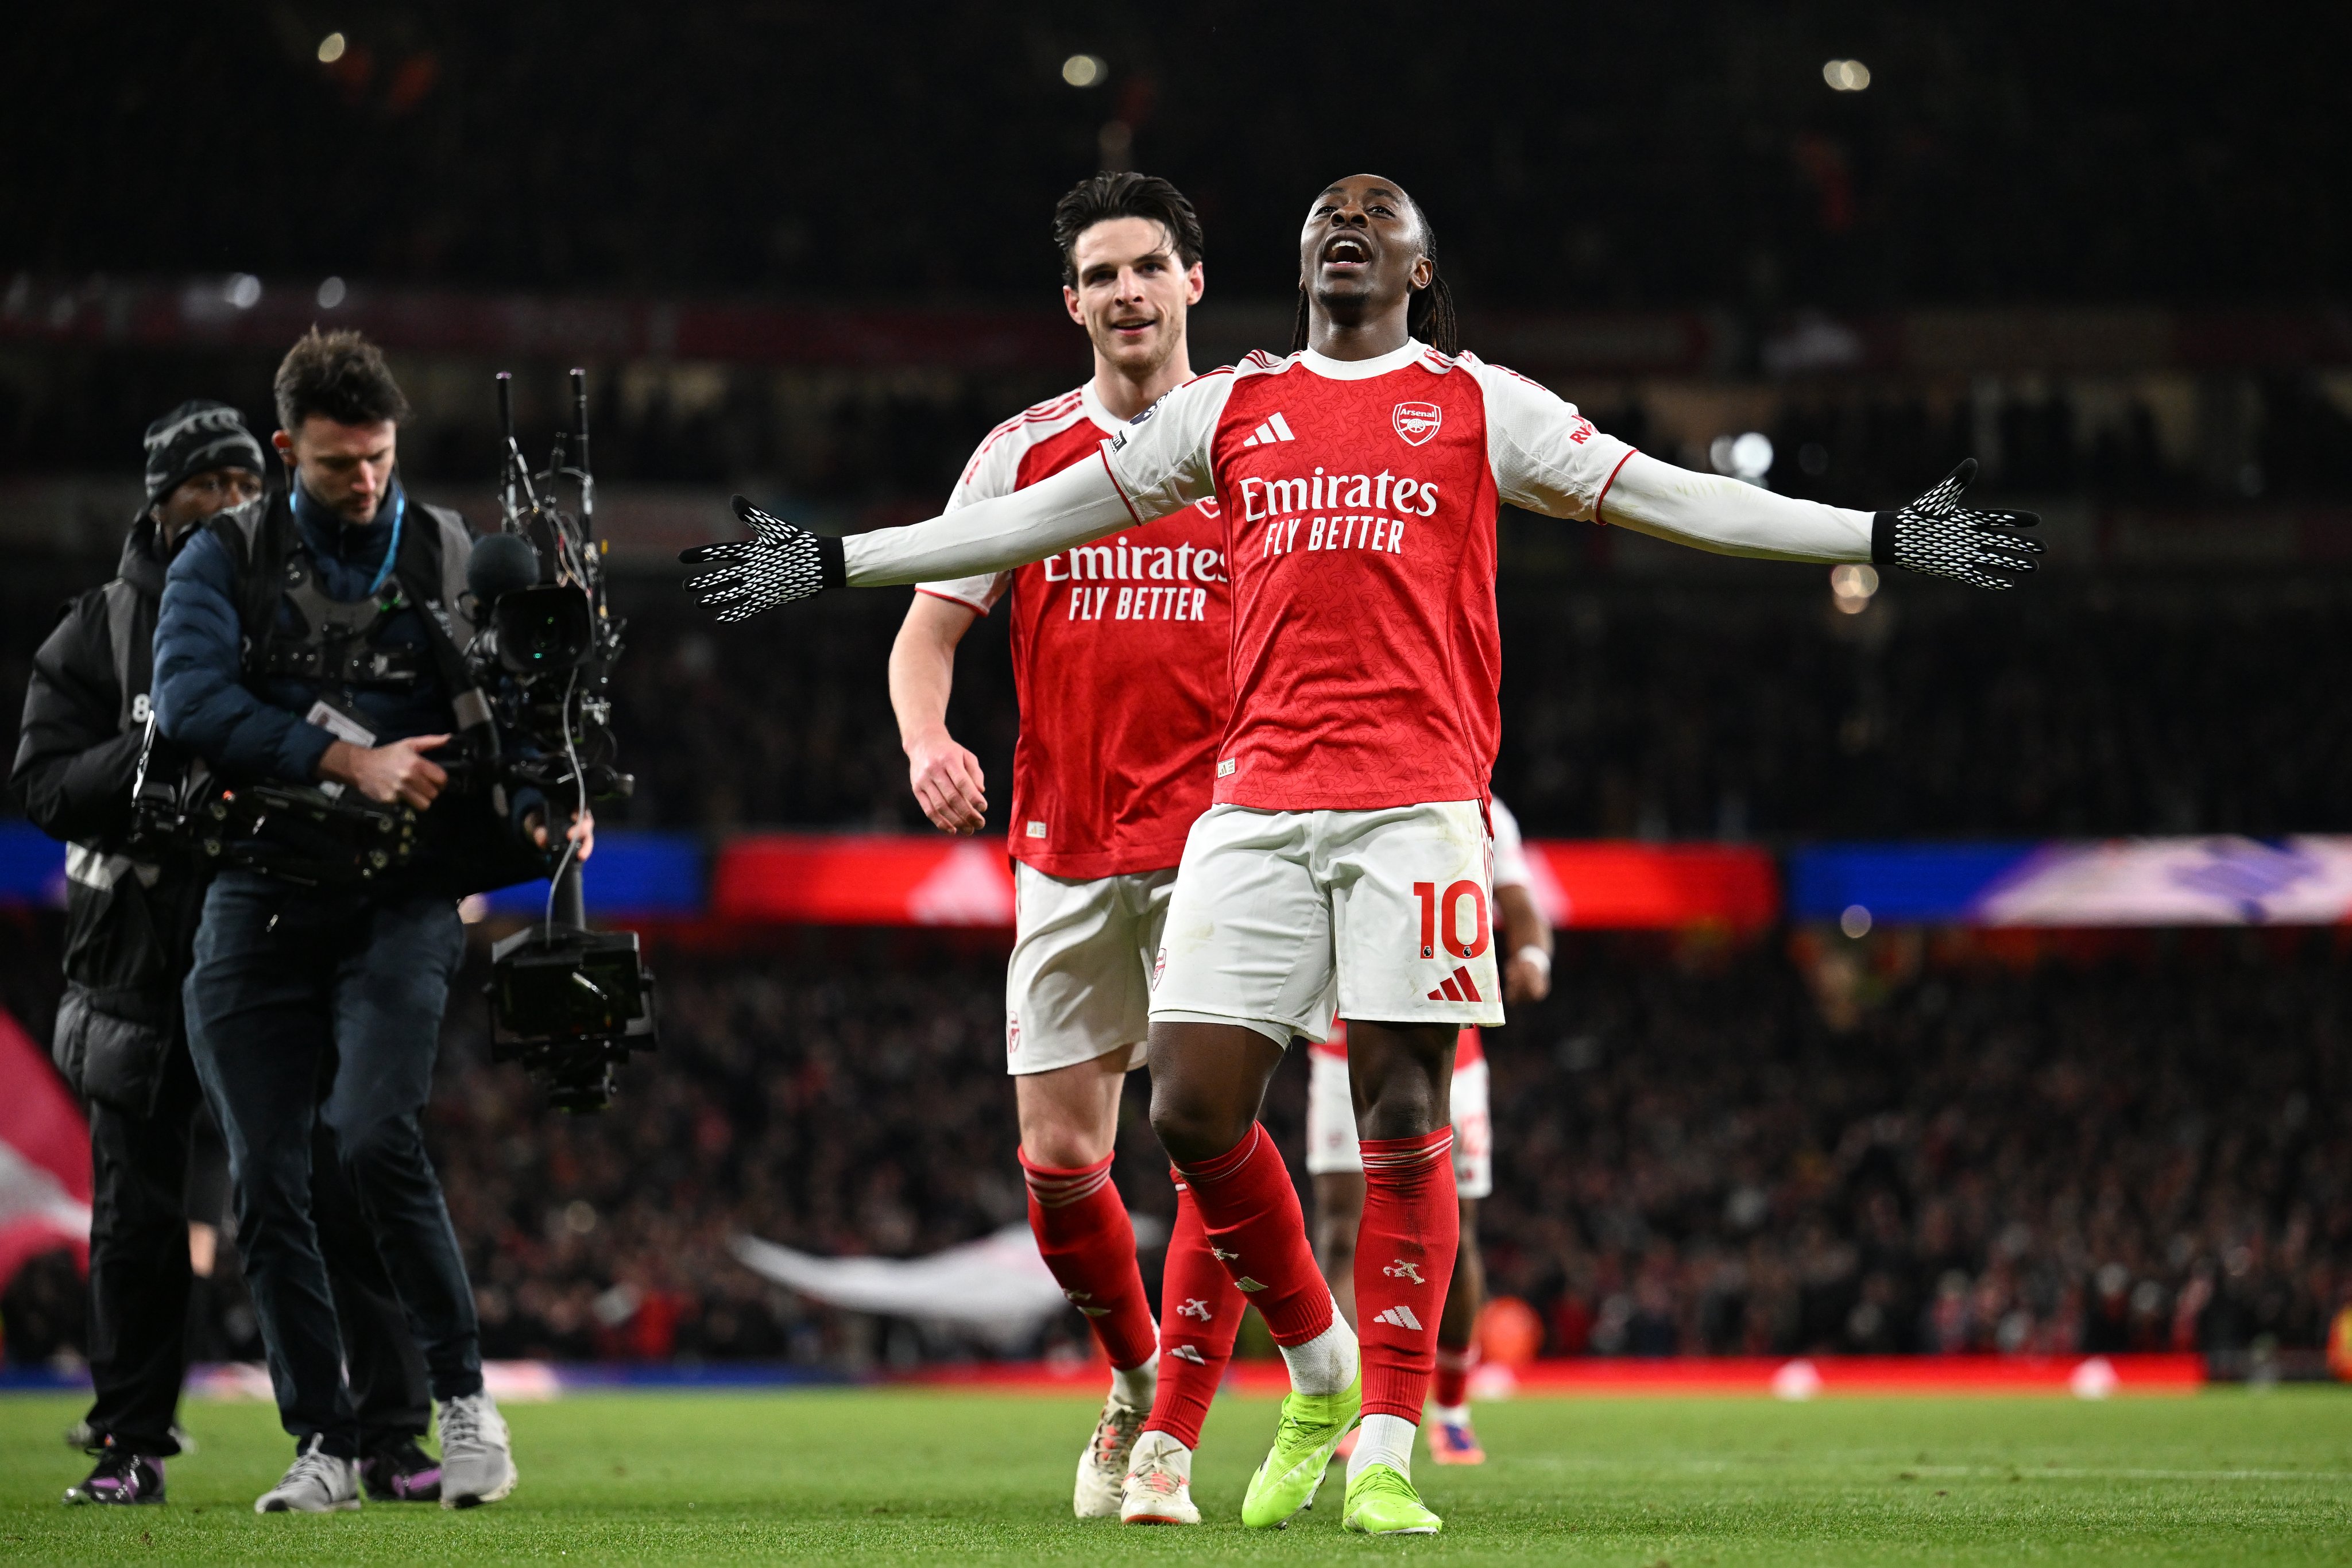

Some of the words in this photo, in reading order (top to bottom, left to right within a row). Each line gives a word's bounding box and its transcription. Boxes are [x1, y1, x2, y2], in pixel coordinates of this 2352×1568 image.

[1400, 408, 1435, 417] Arsenal
[1239, 467, 1439, 522] Emirates
[1263, 518, 1302, 558] FLY
[1307, 516, 1405, 554] BETTER
[1068, 587, 1109, 621] FLY
[1115, 587, 1206, 621] BETTER
[1413, 880, 1489, 959] 10
